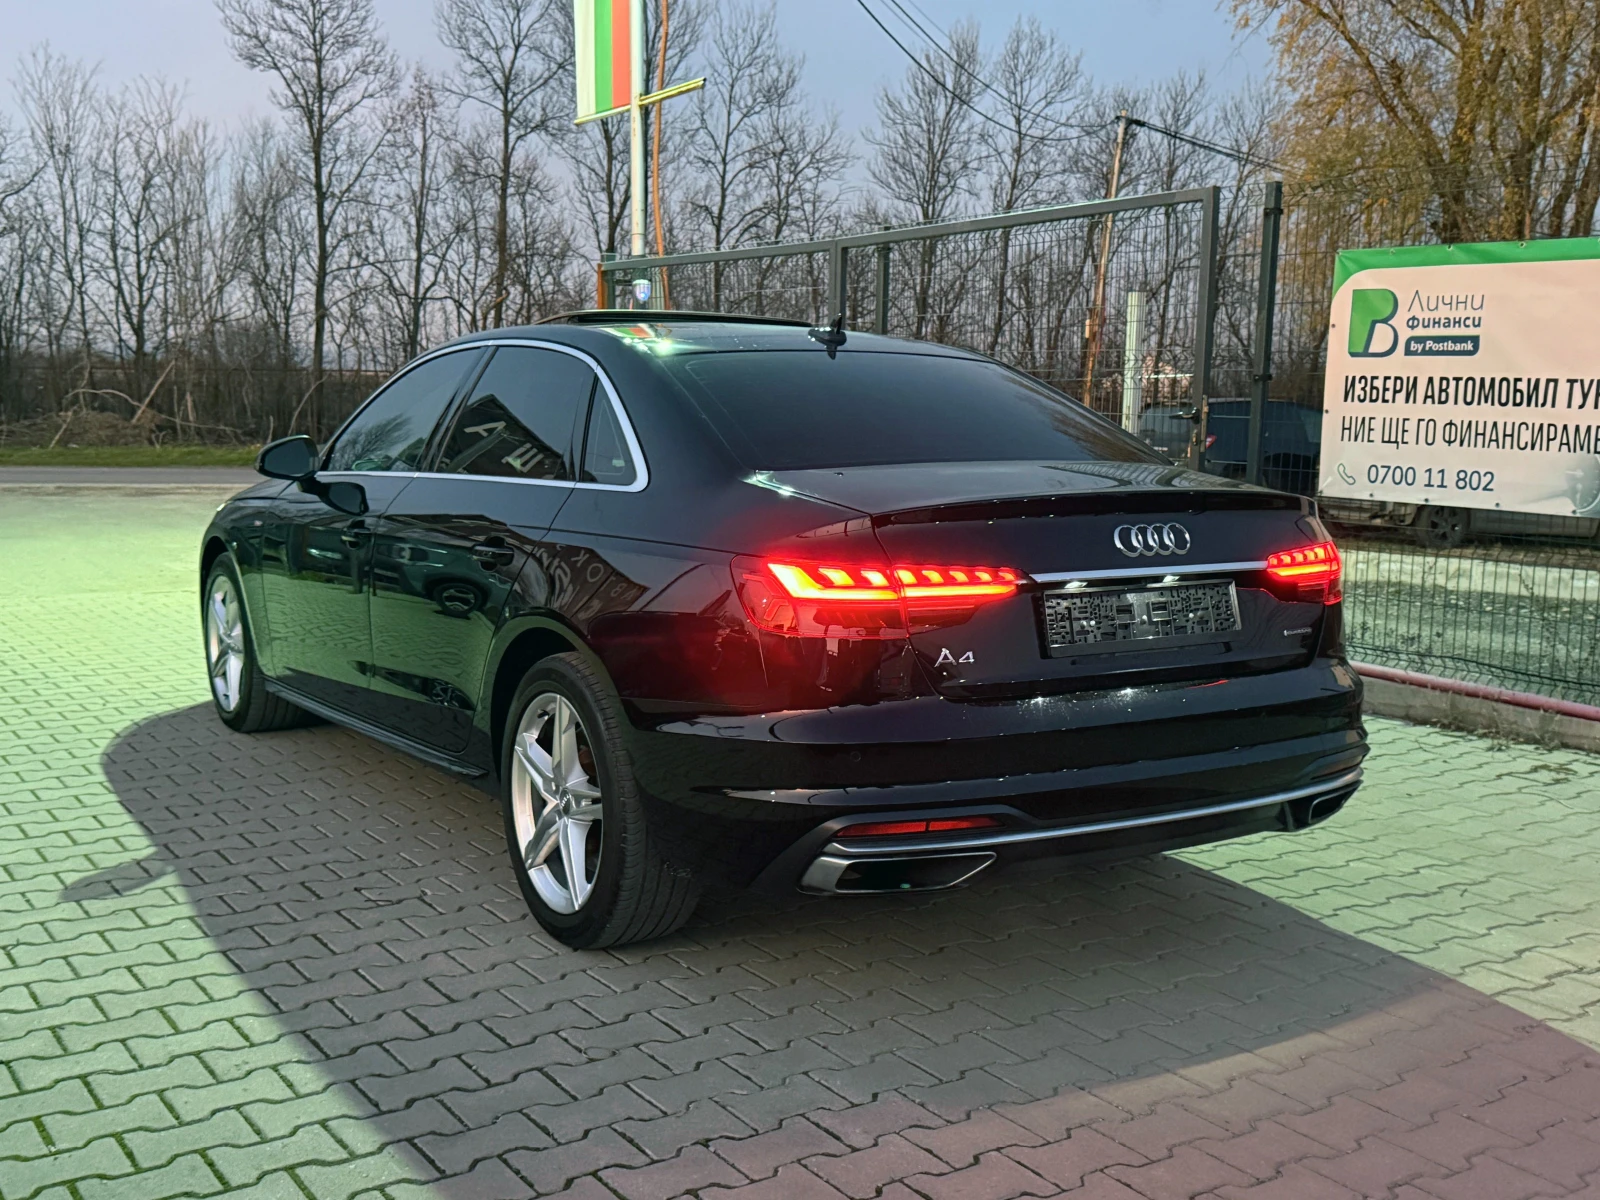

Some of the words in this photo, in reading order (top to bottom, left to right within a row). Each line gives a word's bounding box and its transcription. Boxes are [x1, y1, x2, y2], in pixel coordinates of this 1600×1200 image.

[1407, 290, 1485, 312] Лични
[1410, 340, 1423, 353] by
[1426, 340, 1474, 351] Postbank
[1343, 375, 1418, 404] ИЗБЕРИ
[1423, 376, 1559, 409] АВТОМОБИЛ
[1340, 416, 1376, 443] НИЕ
[1381, 417, 1410, 449] ЩЕ
[1416, 418, 1437, 446] ГО
[1367, 464, 1416, 486] 0700
[1423, 467, 1448, 489] 11
[1455, 469, 1495, 492] 802
[934, 647, 975, 668] A4
